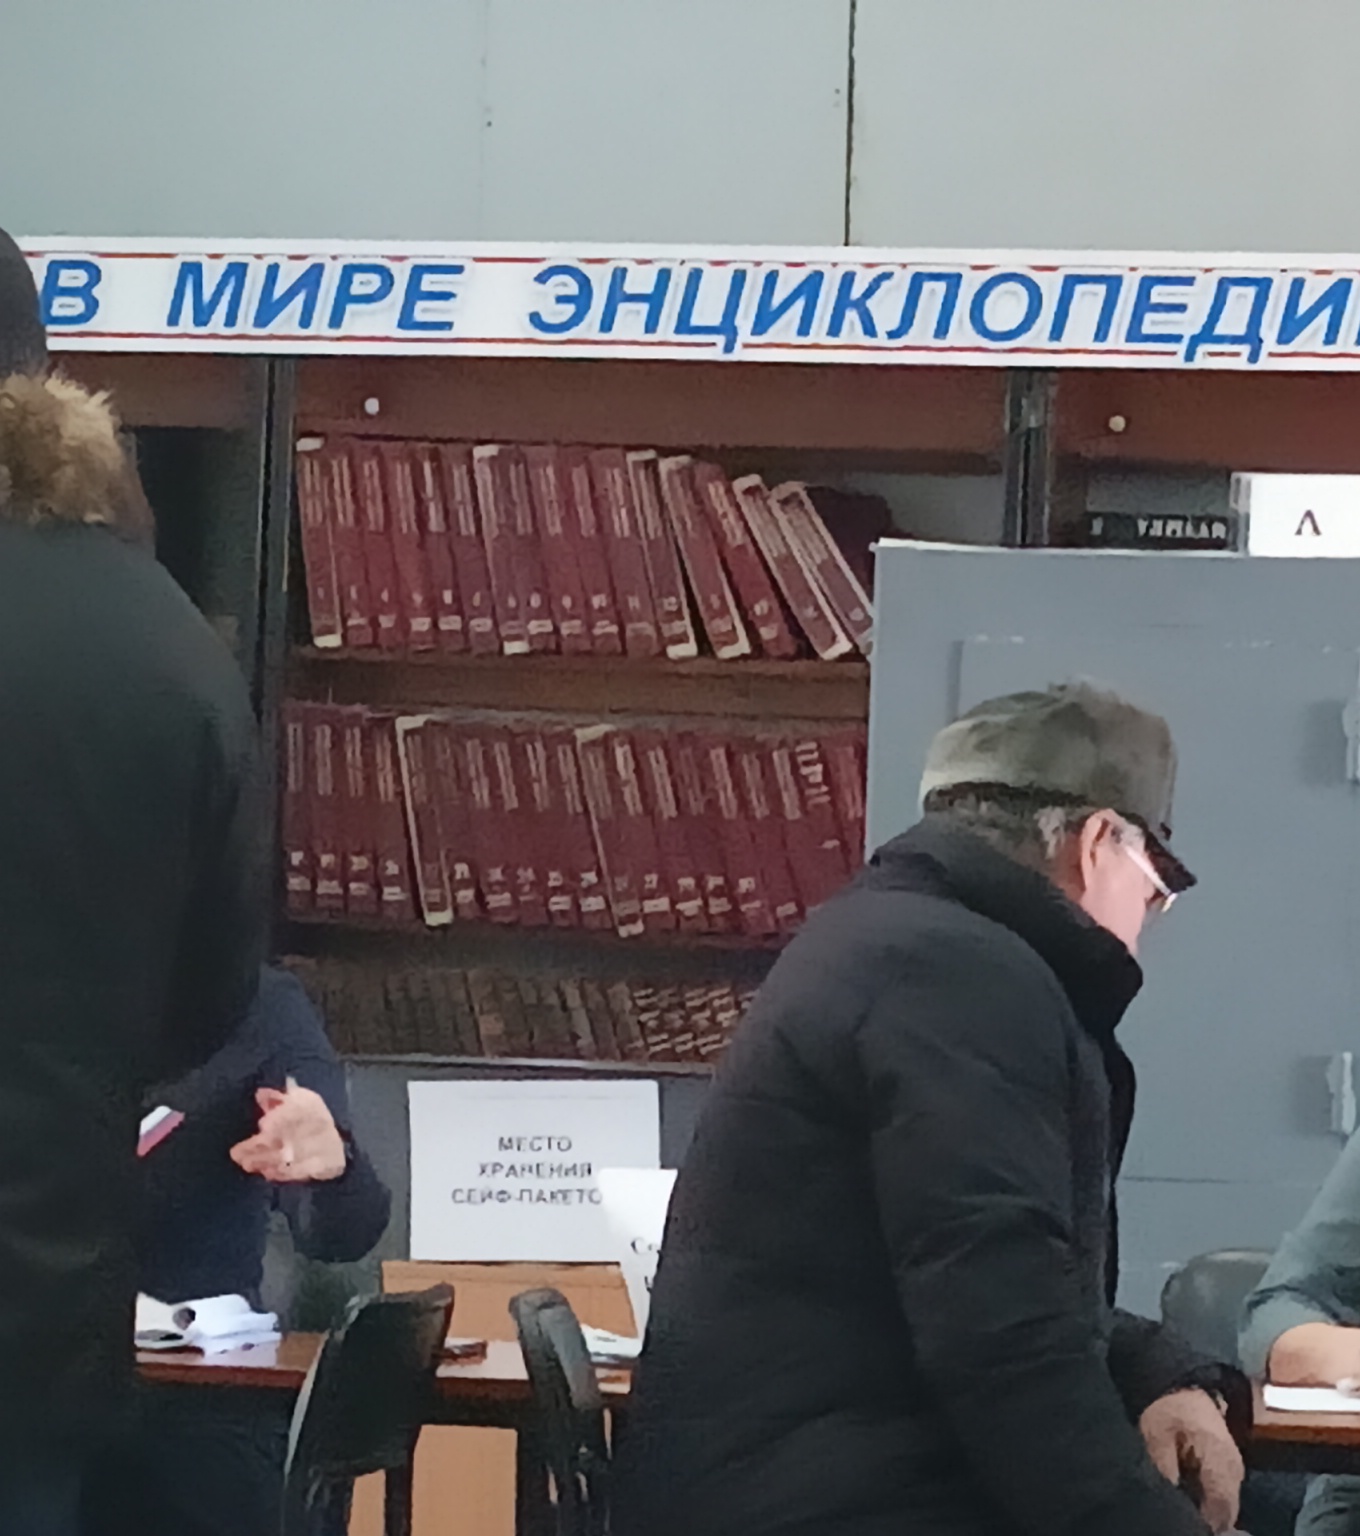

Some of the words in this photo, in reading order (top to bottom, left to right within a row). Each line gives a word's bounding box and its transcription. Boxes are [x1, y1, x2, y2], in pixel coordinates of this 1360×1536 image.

[42, 260, 102, 326] В
[166, 261, 465, 331] МИРЕ
[497, 1136, 573, 1152] МЕСТО
[478, 1162, 593, 1179] ХРАНЕНИЯ
[451, 1187, 603, 1205] СЕЙФ-ПАКЕТО
